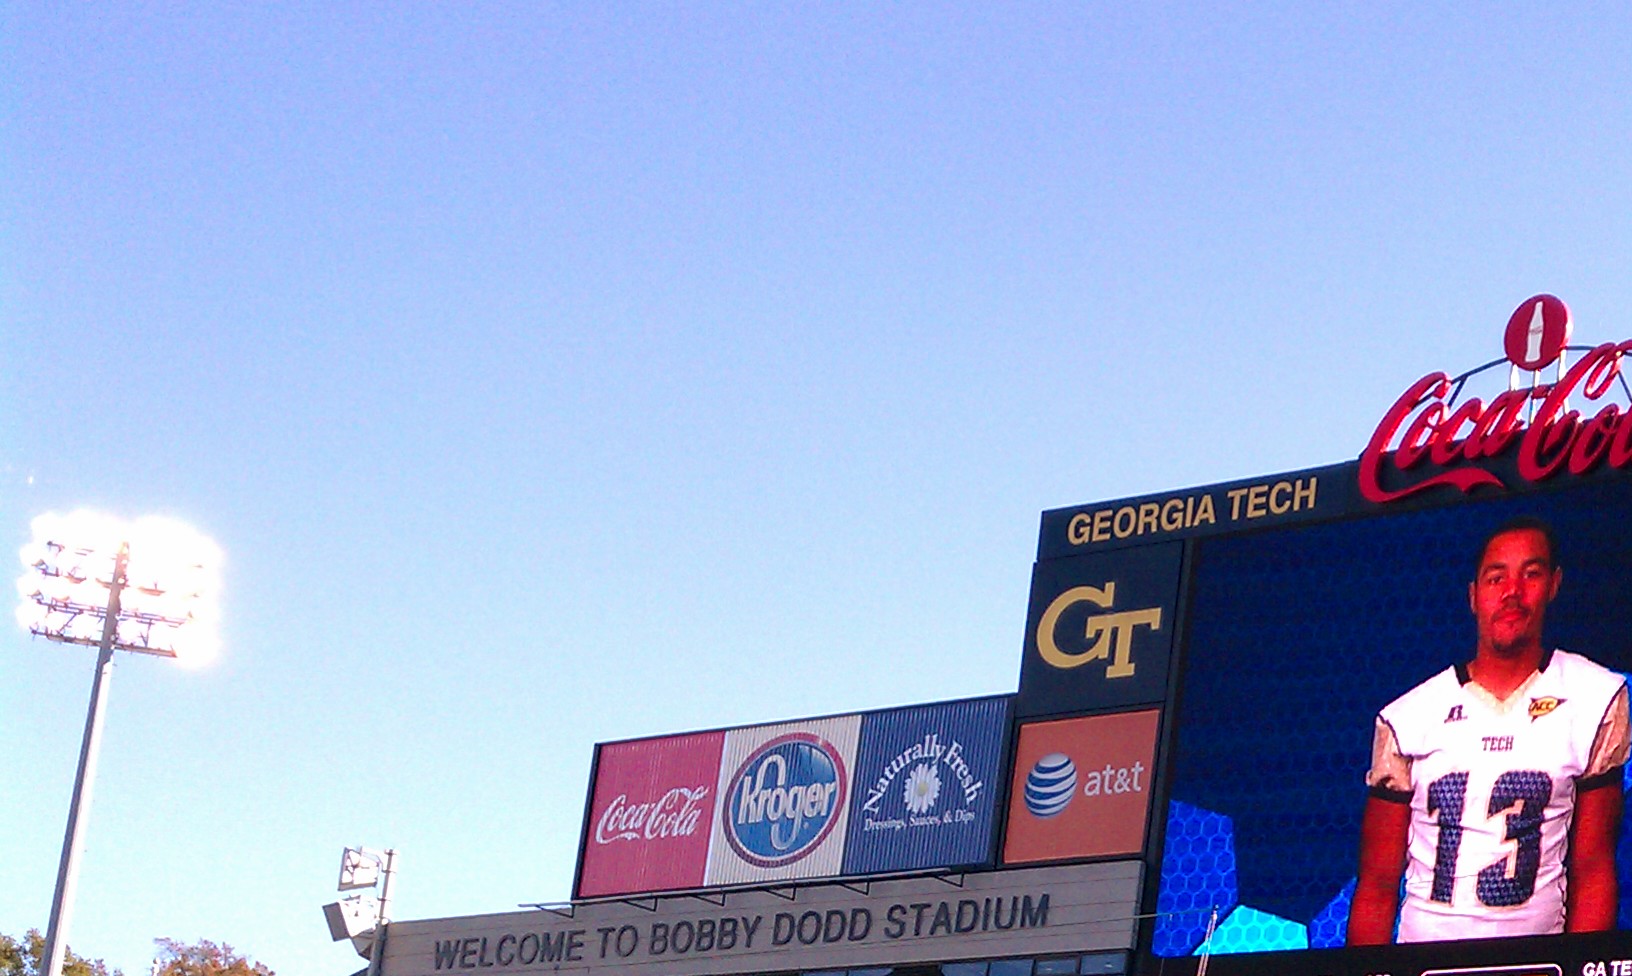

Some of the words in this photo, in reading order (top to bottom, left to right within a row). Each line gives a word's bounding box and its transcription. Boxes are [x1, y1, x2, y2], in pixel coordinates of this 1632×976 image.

[1066, 495, 1217, 546] GEORGIA
[1226, 477, 1319, 522] TECH
[1036, 582, 1161, 679] GT
[862, 733, 947, 814] Naturally
[942, 740, 983, 806] Fresh
[1083, 760, 1145, 797] at&t
[1481, 735, 1515, 752] TECH
[595, 785, 709, 845] Coca-Cola
[737, 754, 837, 851] Kroger
[954, 809, 976, 825] Dips
[1426, 769, 1553, 908] 13
[433, 929, 585, 970] WELCOME
[597, 924, 639, 959] TO
[648, 915, 762, 955] BOBBY
[772, 906, 872, 947] DODD
[883, 893, 1050, 939] STADIUM
